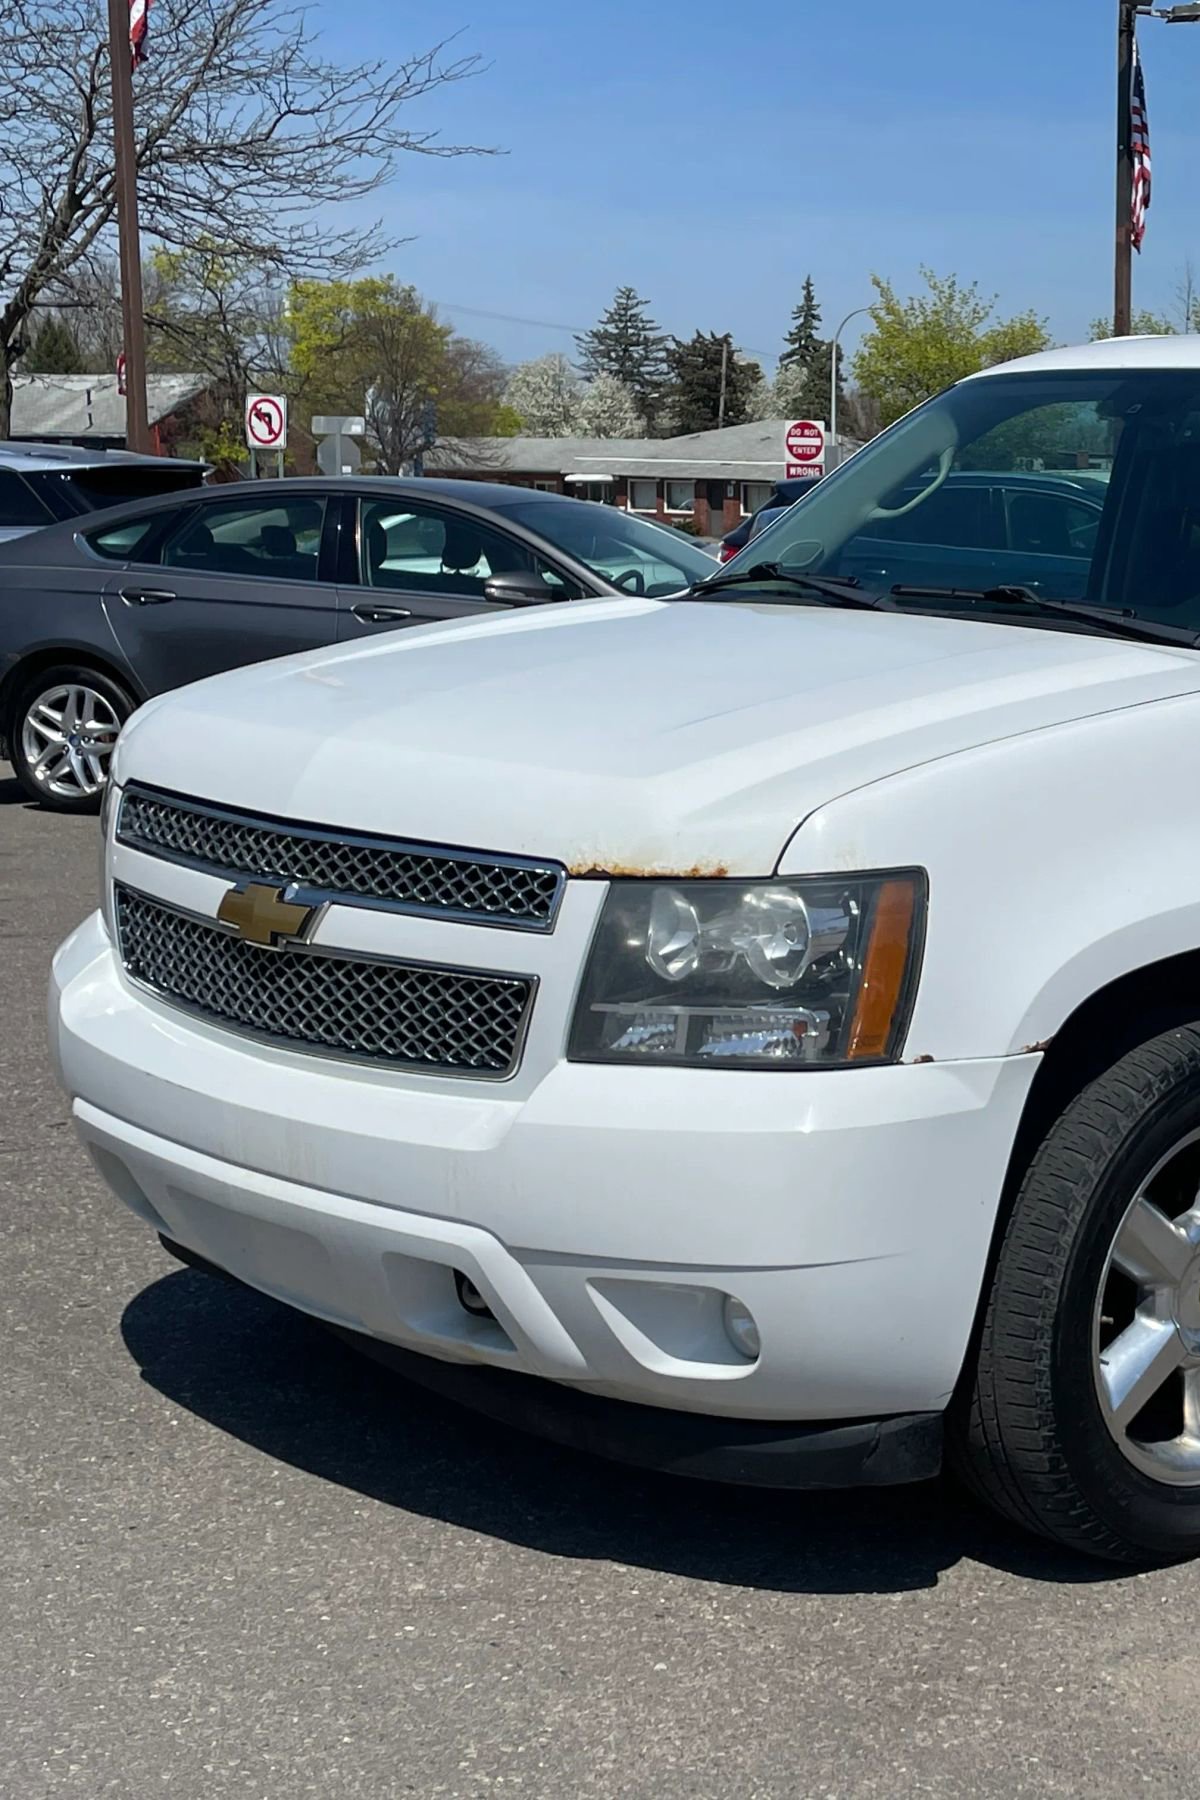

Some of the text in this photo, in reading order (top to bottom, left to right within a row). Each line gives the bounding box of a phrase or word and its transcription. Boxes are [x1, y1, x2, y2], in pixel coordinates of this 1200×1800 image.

[790, 428, 819, 436] DO NOT
[792, 446, 817, 454] ENTER
[789, 466, 820, 477] WRONG
